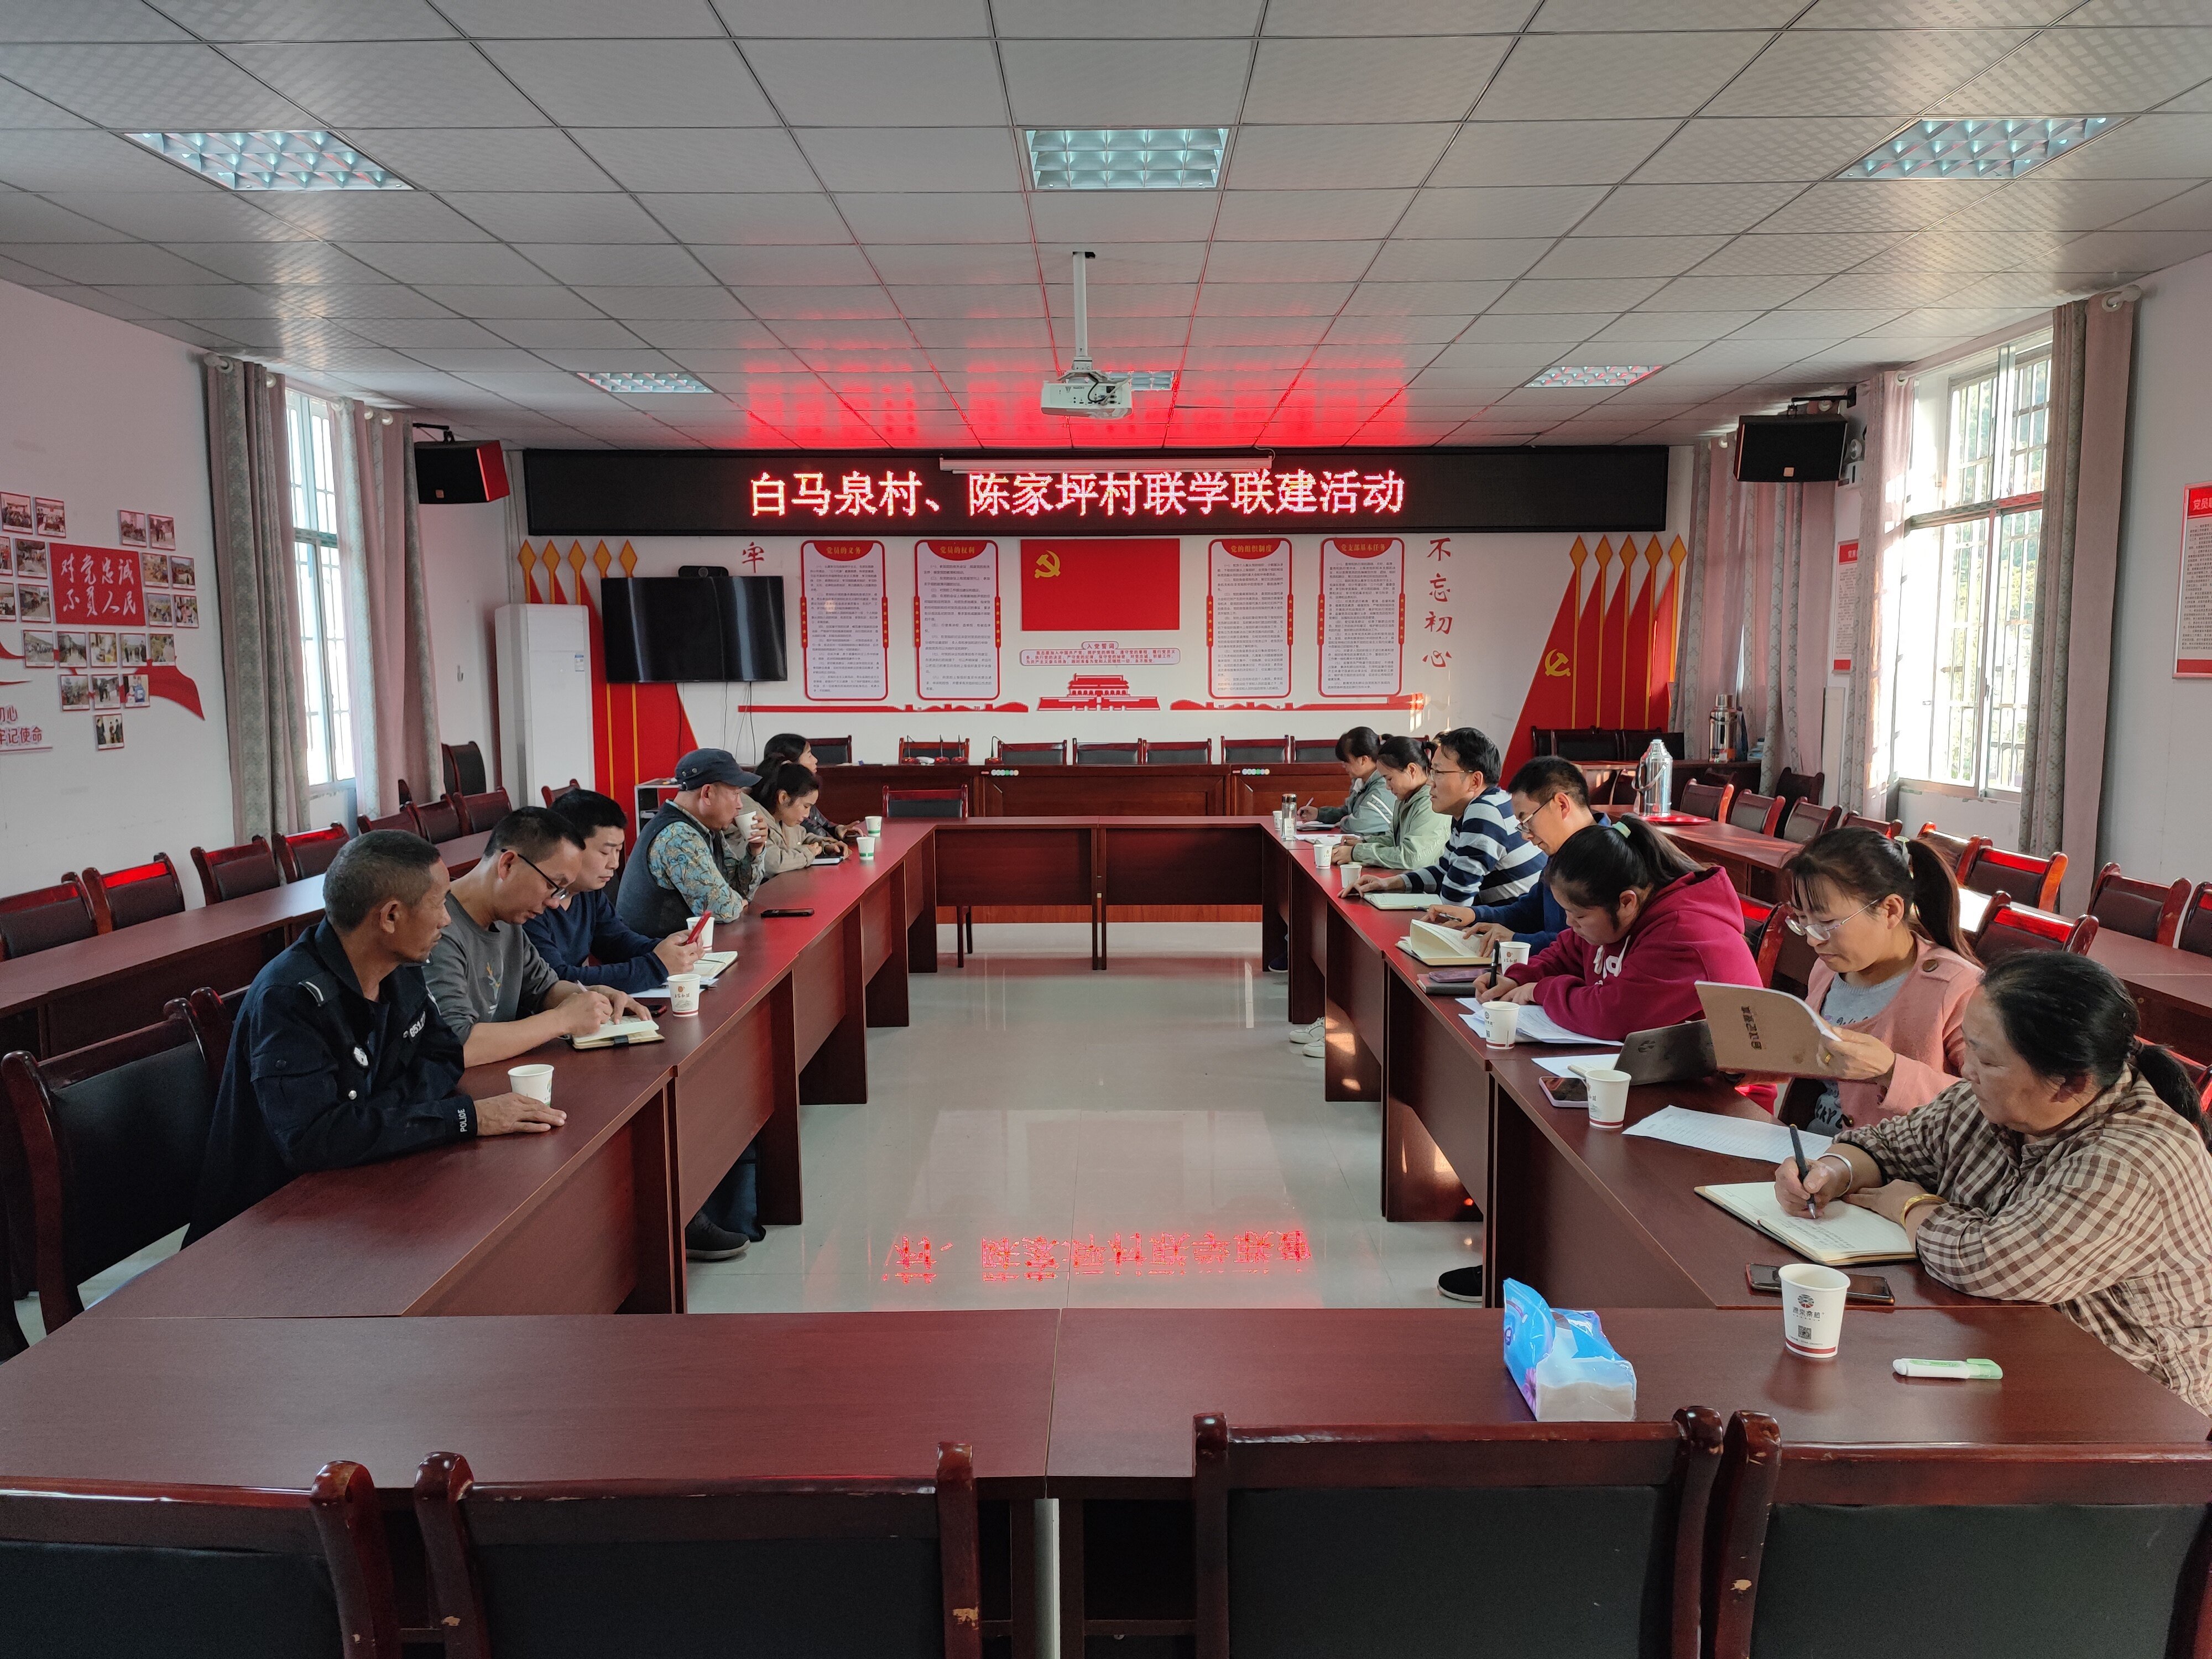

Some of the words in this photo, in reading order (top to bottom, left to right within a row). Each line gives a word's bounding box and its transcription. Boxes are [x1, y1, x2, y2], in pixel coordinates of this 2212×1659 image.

[750, 468, 1405, 517] 白马泉村、陈家坪村联学联建活动
[742, 541, 764, 573] 牢
[940, 546, 975, 554] 党员的权利
[60, 552, 134, 585] 对党忠诚
[1422, 537, 1453, 667] 不忘初心
[457, 1108, 468, 1133] POLICE
